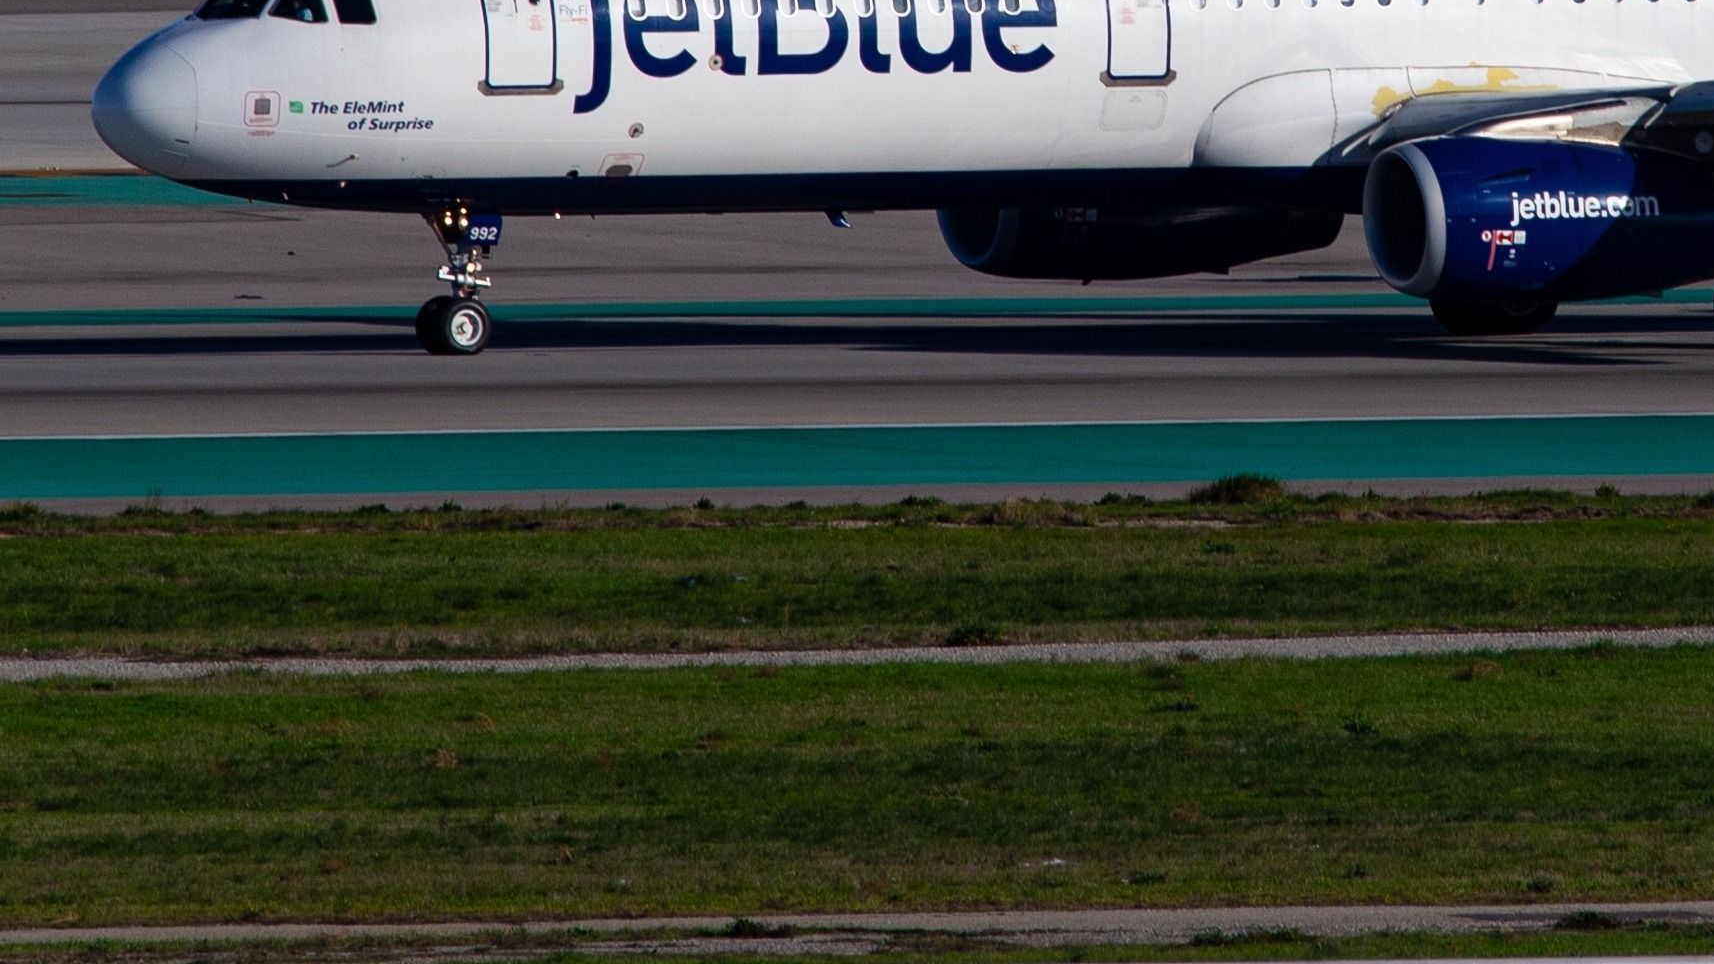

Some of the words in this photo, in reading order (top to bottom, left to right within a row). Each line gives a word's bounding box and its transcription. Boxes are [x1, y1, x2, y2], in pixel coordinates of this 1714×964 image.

[310, 101, 339, 115] The
[342, 100, 405, 115] EleMint
[347, 118, 365, 131] of
[368, 117, 434, 133] Surprise
[1510, 190, 1660, 227] jetblue.com
[469, 226, 498, 241] 992
